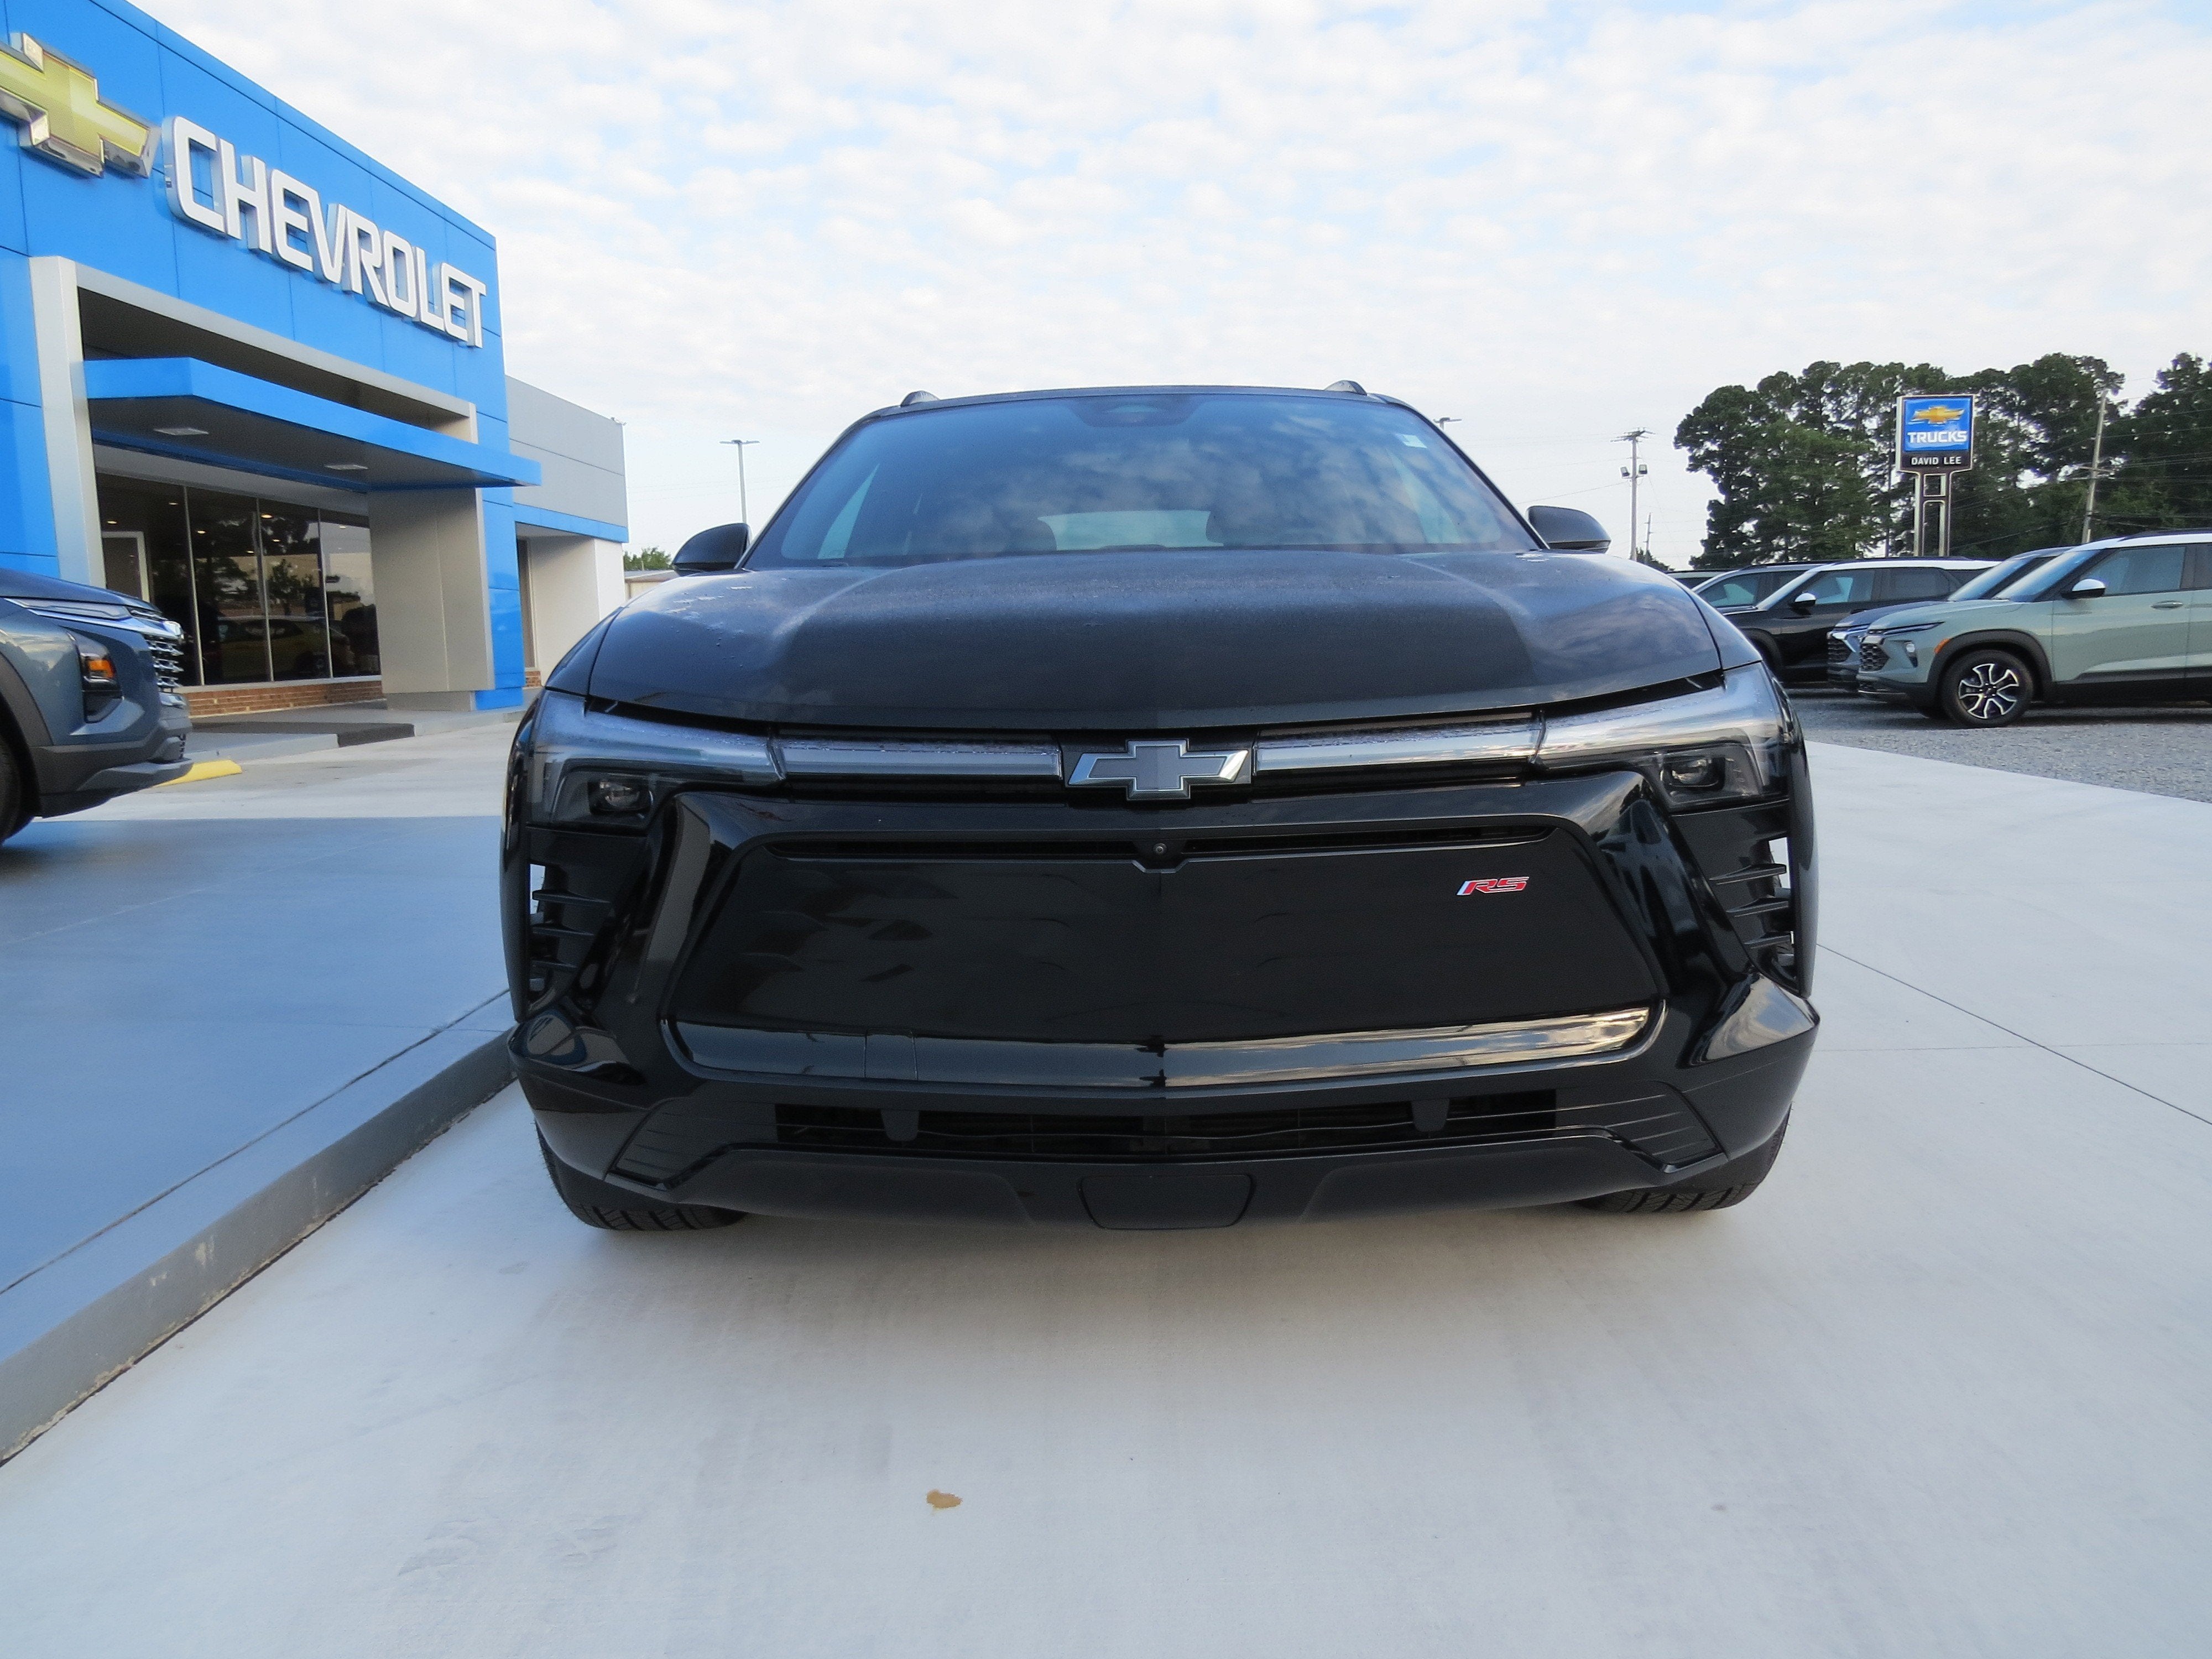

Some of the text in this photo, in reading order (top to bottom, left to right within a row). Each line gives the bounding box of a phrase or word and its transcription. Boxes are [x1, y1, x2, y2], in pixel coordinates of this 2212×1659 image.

[167, 116, 487, 348] CHEVROLET
[1907, 431, 1968, 444] TRUCKS
[1911, 456, 1961, 466] DAVID LEE
[1457, 876, 1530, 896] RS
